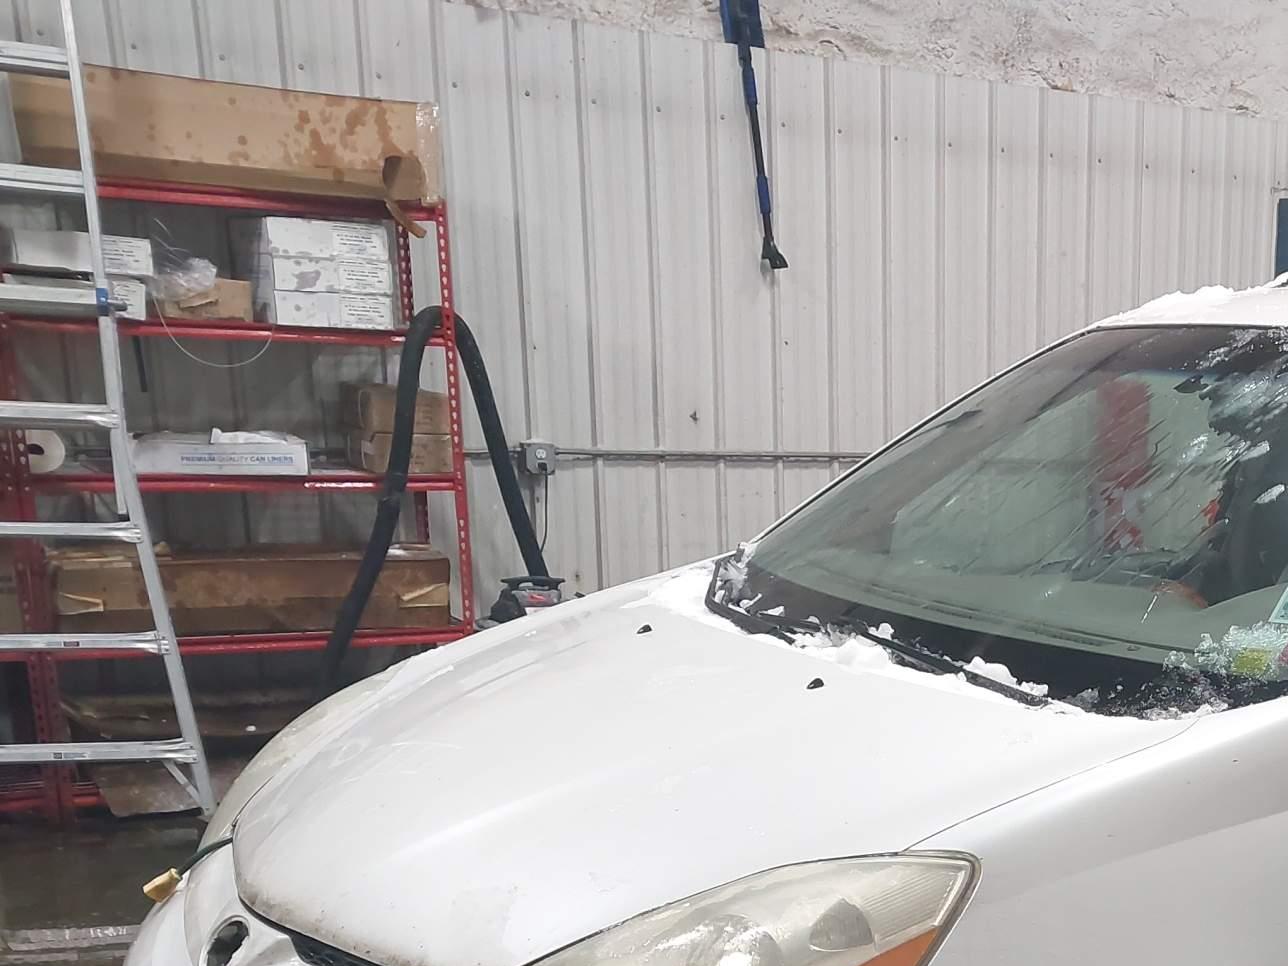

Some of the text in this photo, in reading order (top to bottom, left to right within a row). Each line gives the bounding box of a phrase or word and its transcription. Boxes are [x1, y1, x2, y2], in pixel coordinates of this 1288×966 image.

[180, 455, 216, 463] PREMIUM
[218, 455, 249, 463] QUALITY
[267, 456, 294, 464] LINERS
